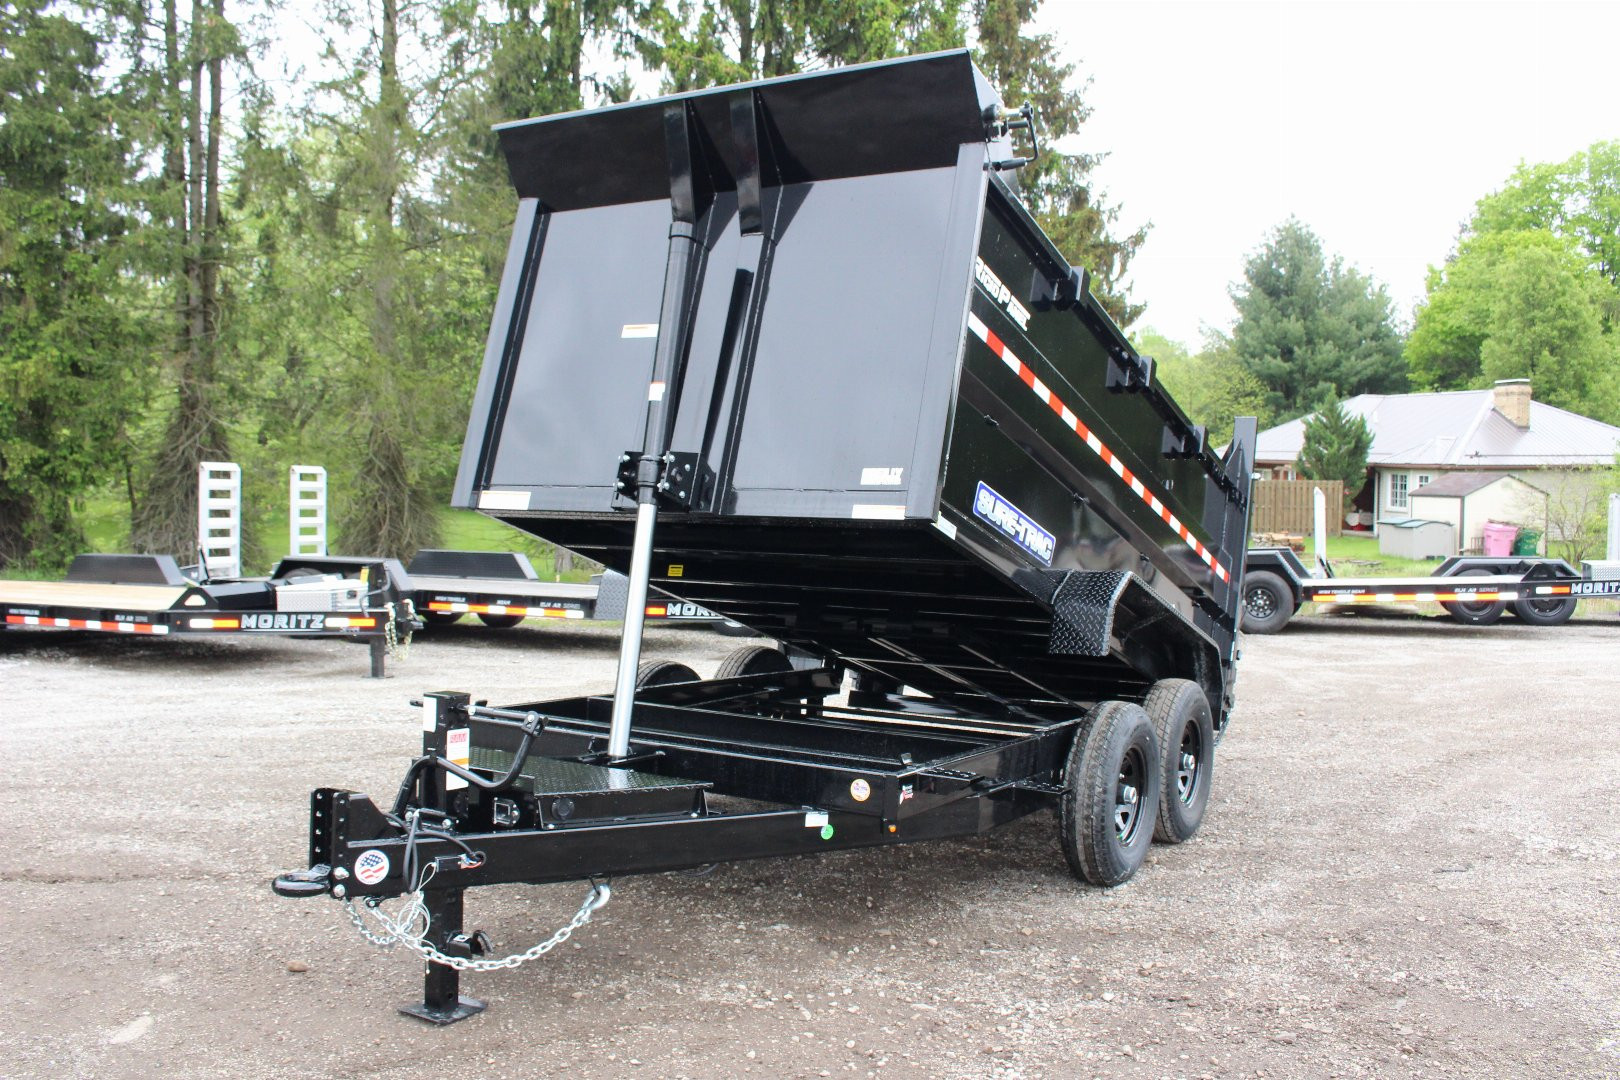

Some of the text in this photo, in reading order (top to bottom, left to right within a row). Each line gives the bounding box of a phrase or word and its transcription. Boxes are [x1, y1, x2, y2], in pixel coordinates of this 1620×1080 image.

[977, 489, 1053, 560] SURE-TRAC
[1571, 582, 1620, 594] MORIT
[241, 614, 325, 628] MORITZ
